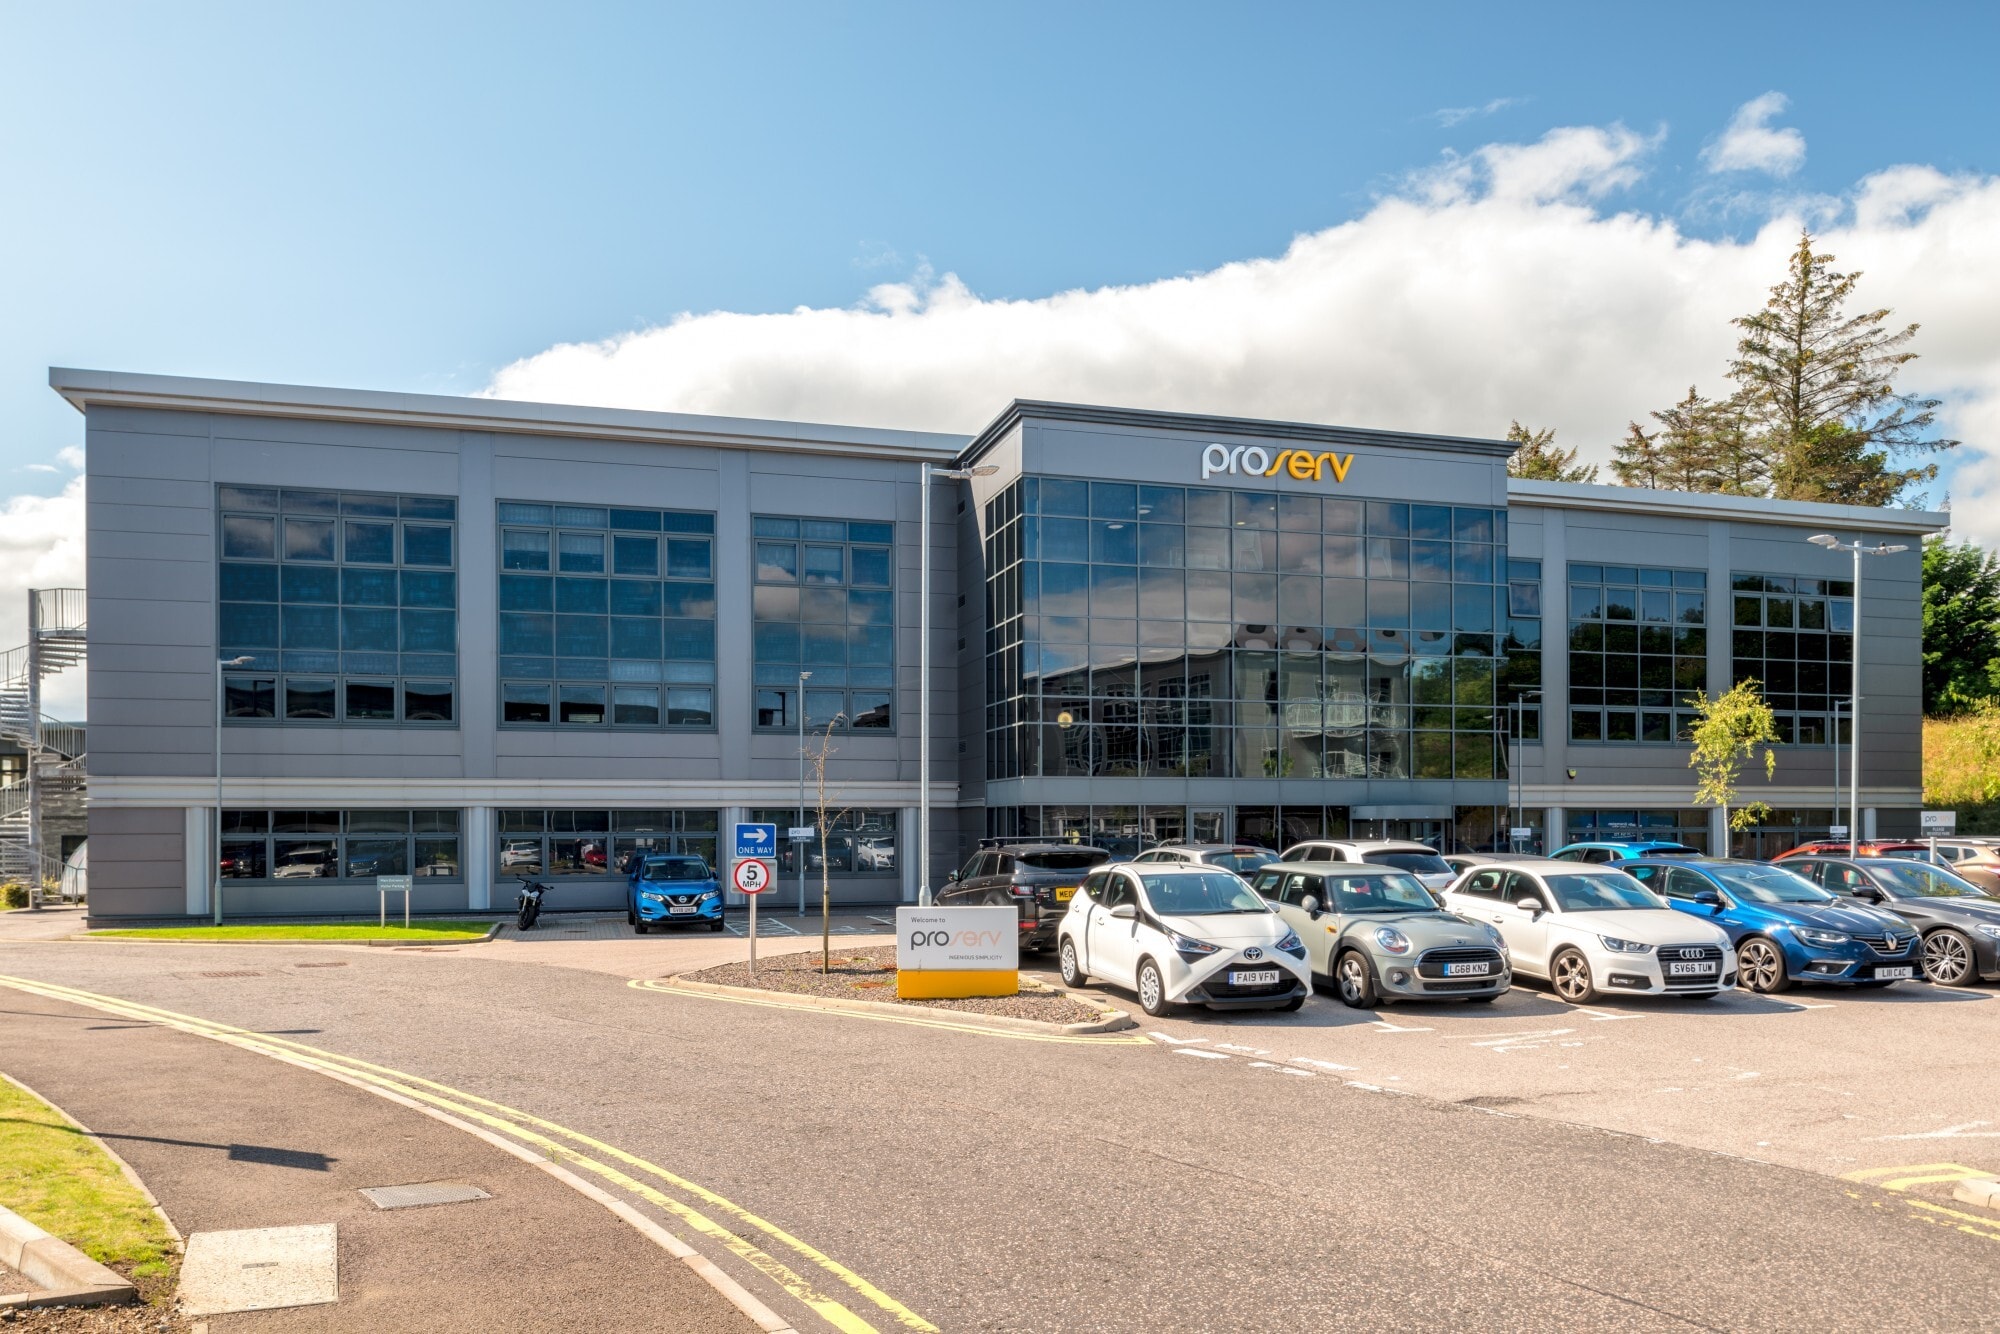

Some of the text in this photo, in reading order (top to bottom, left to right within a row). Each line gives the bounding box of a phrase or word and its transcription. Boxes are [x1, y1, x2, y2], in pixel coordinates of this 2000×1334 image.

[1201, 443, 1355, 483] proserv
[738, 846, 773, 854] ONE WAY
[746, 865, 758, 880] 5
[911, 930, 1002, 951] proserv
[1449, 963, 1488, 974] LG68 KNZ
[1674, 963, 1712, 973] SV66 TUW
[1893, 968, 1906, 977] CAC
[1236, 972, 1276, 982] FA19 VFN
